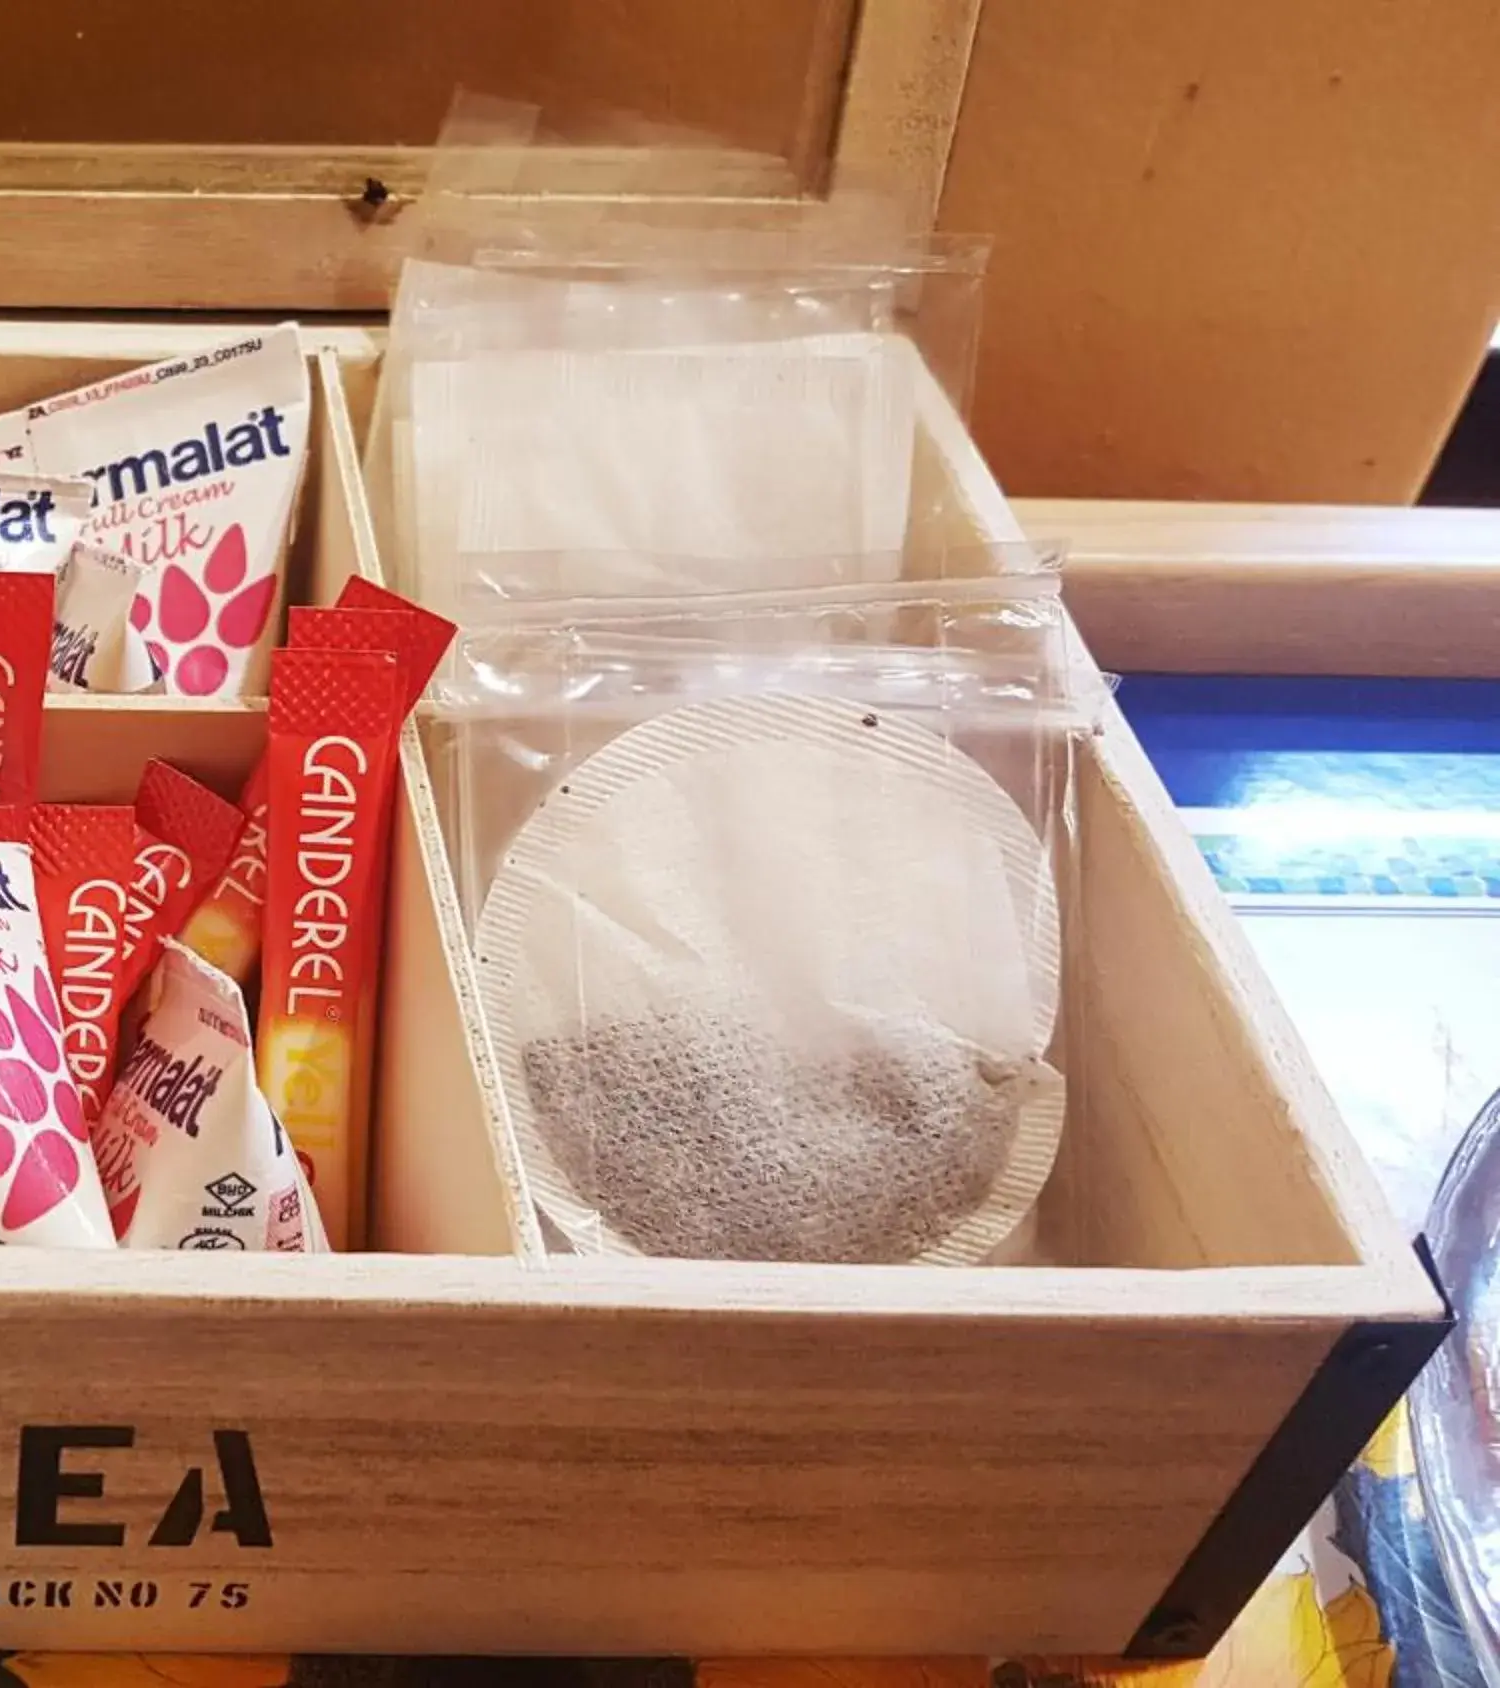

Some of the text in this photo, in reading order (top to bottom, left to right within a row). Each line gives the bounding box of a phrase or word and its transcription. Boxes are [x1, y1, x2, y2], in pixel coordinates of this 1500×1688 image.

[137, 480, 235, 520] Cream
[287, 735, 369, 1016] CANDEREL
[94, 1581, 159, 1609] NO
[188, 1581, 252, 1609] 75
